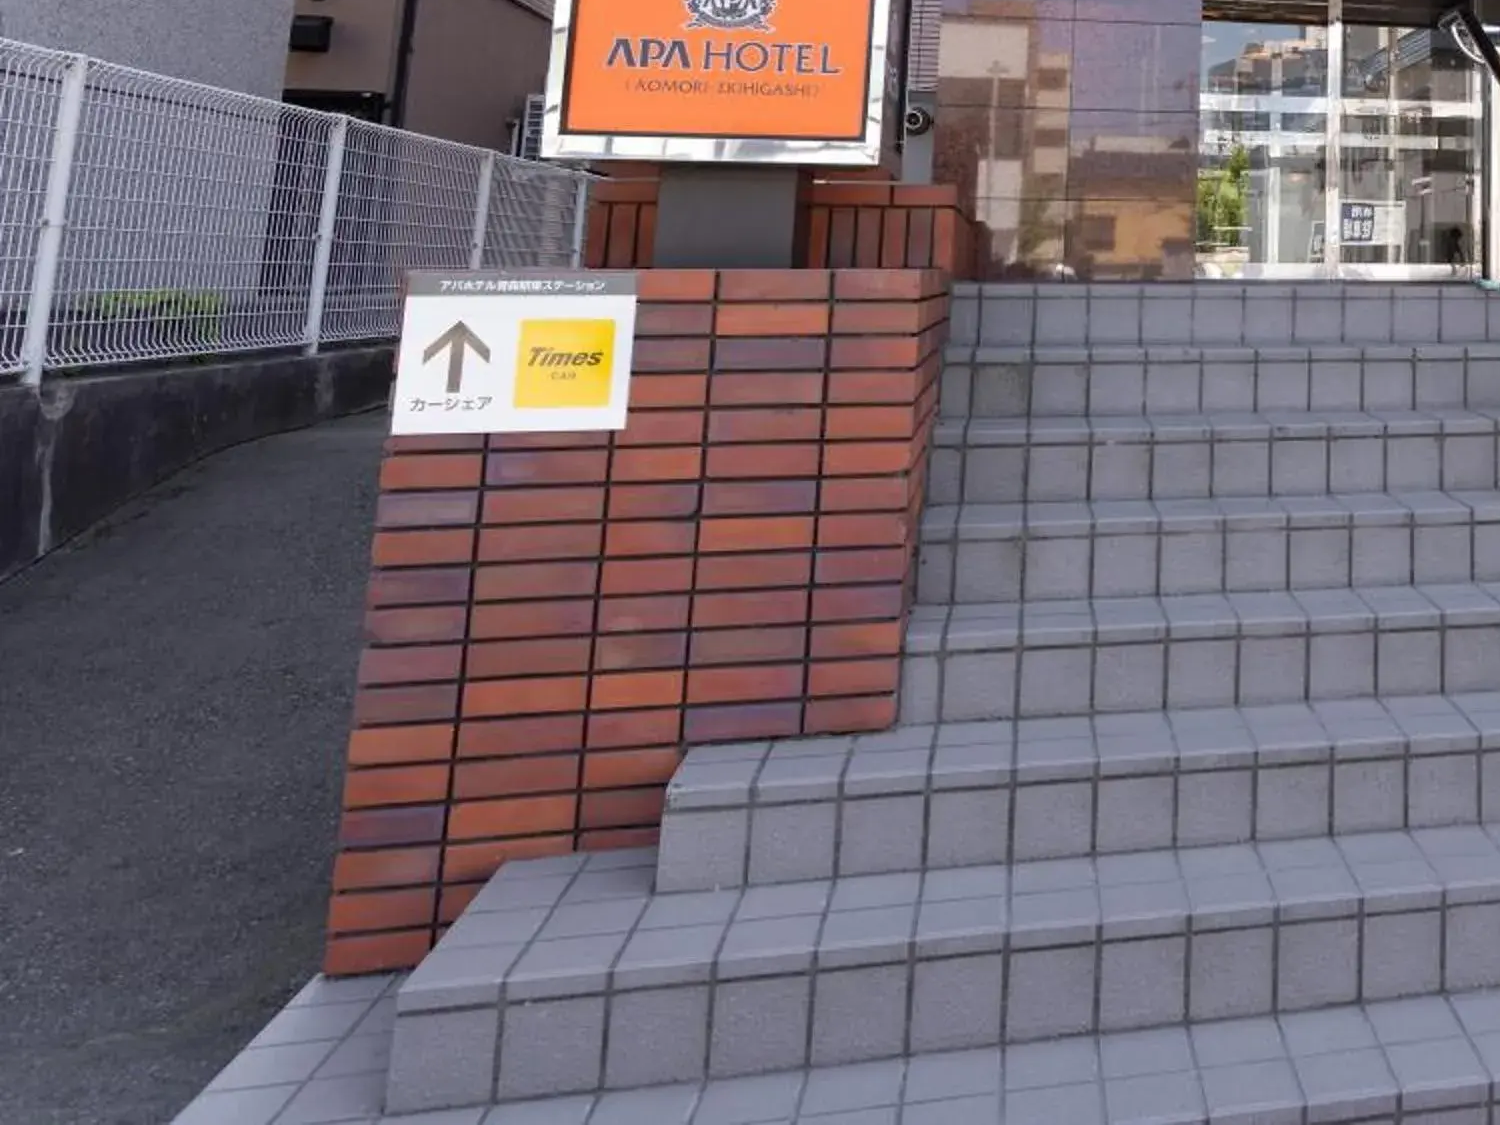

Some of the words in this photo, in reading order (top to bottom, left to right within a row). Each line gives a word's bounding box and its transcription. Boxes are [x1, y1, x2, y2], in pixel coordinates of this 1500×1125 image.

[606, 37, 692, 69] APA
[702, 40, 840, 75] HOTEL
[527, 346, 604, 368] Times
[409, 396, 493, 412] カーシェア
